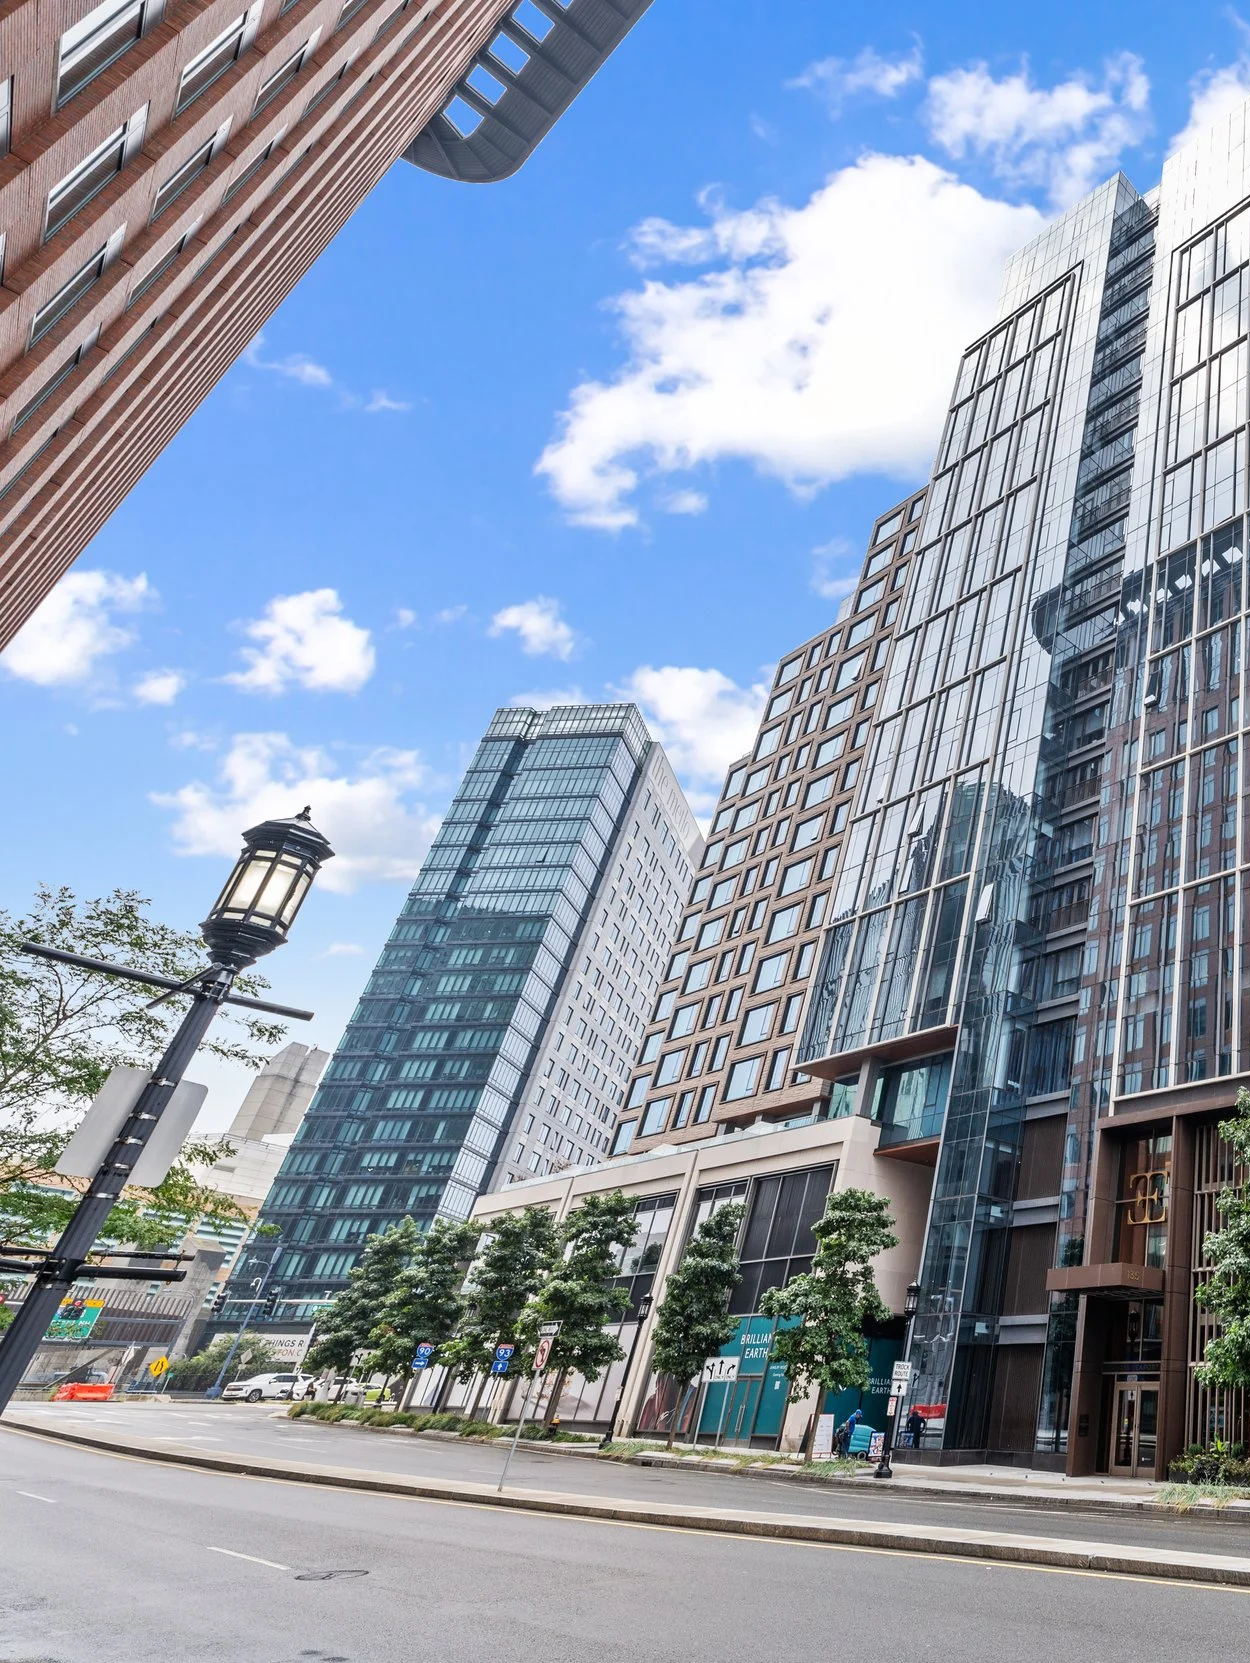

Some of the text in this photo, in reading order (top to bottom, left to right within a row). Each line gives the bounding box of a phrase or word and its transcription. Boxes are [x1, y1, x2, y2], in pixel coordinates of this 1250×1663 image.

[740, 1333, 772, 1344] BRILLIAN
[499, 1349, 511, 1358] 93
[745, 1348, 769, 1358] EARTH
[871, 1386, 891, 1394] EARTH
